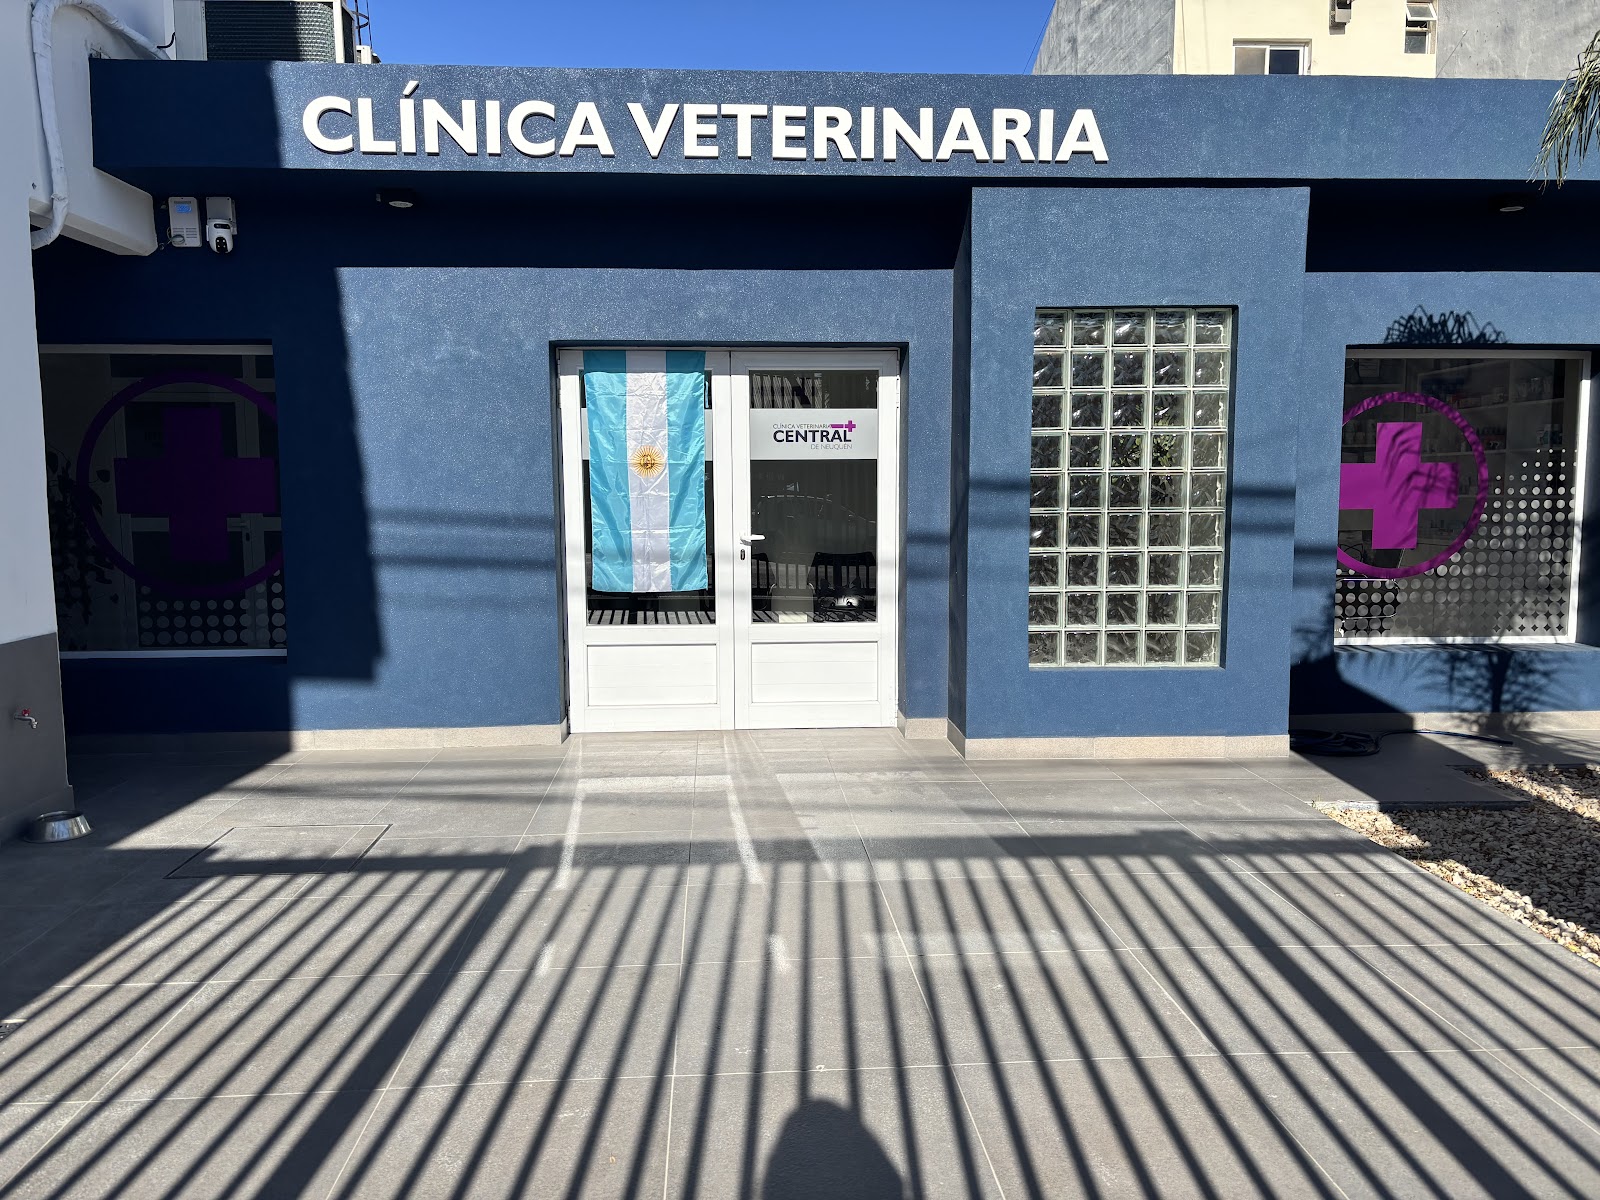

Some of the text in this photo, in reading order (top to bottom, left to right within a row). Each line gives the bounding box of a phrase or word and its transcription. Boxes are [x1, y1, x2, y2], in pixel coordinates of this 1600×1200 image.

[302, 80, 1109, 164] CLÍNICA VETERINARIA
[773, 430, 852, 443] CENTRAL
